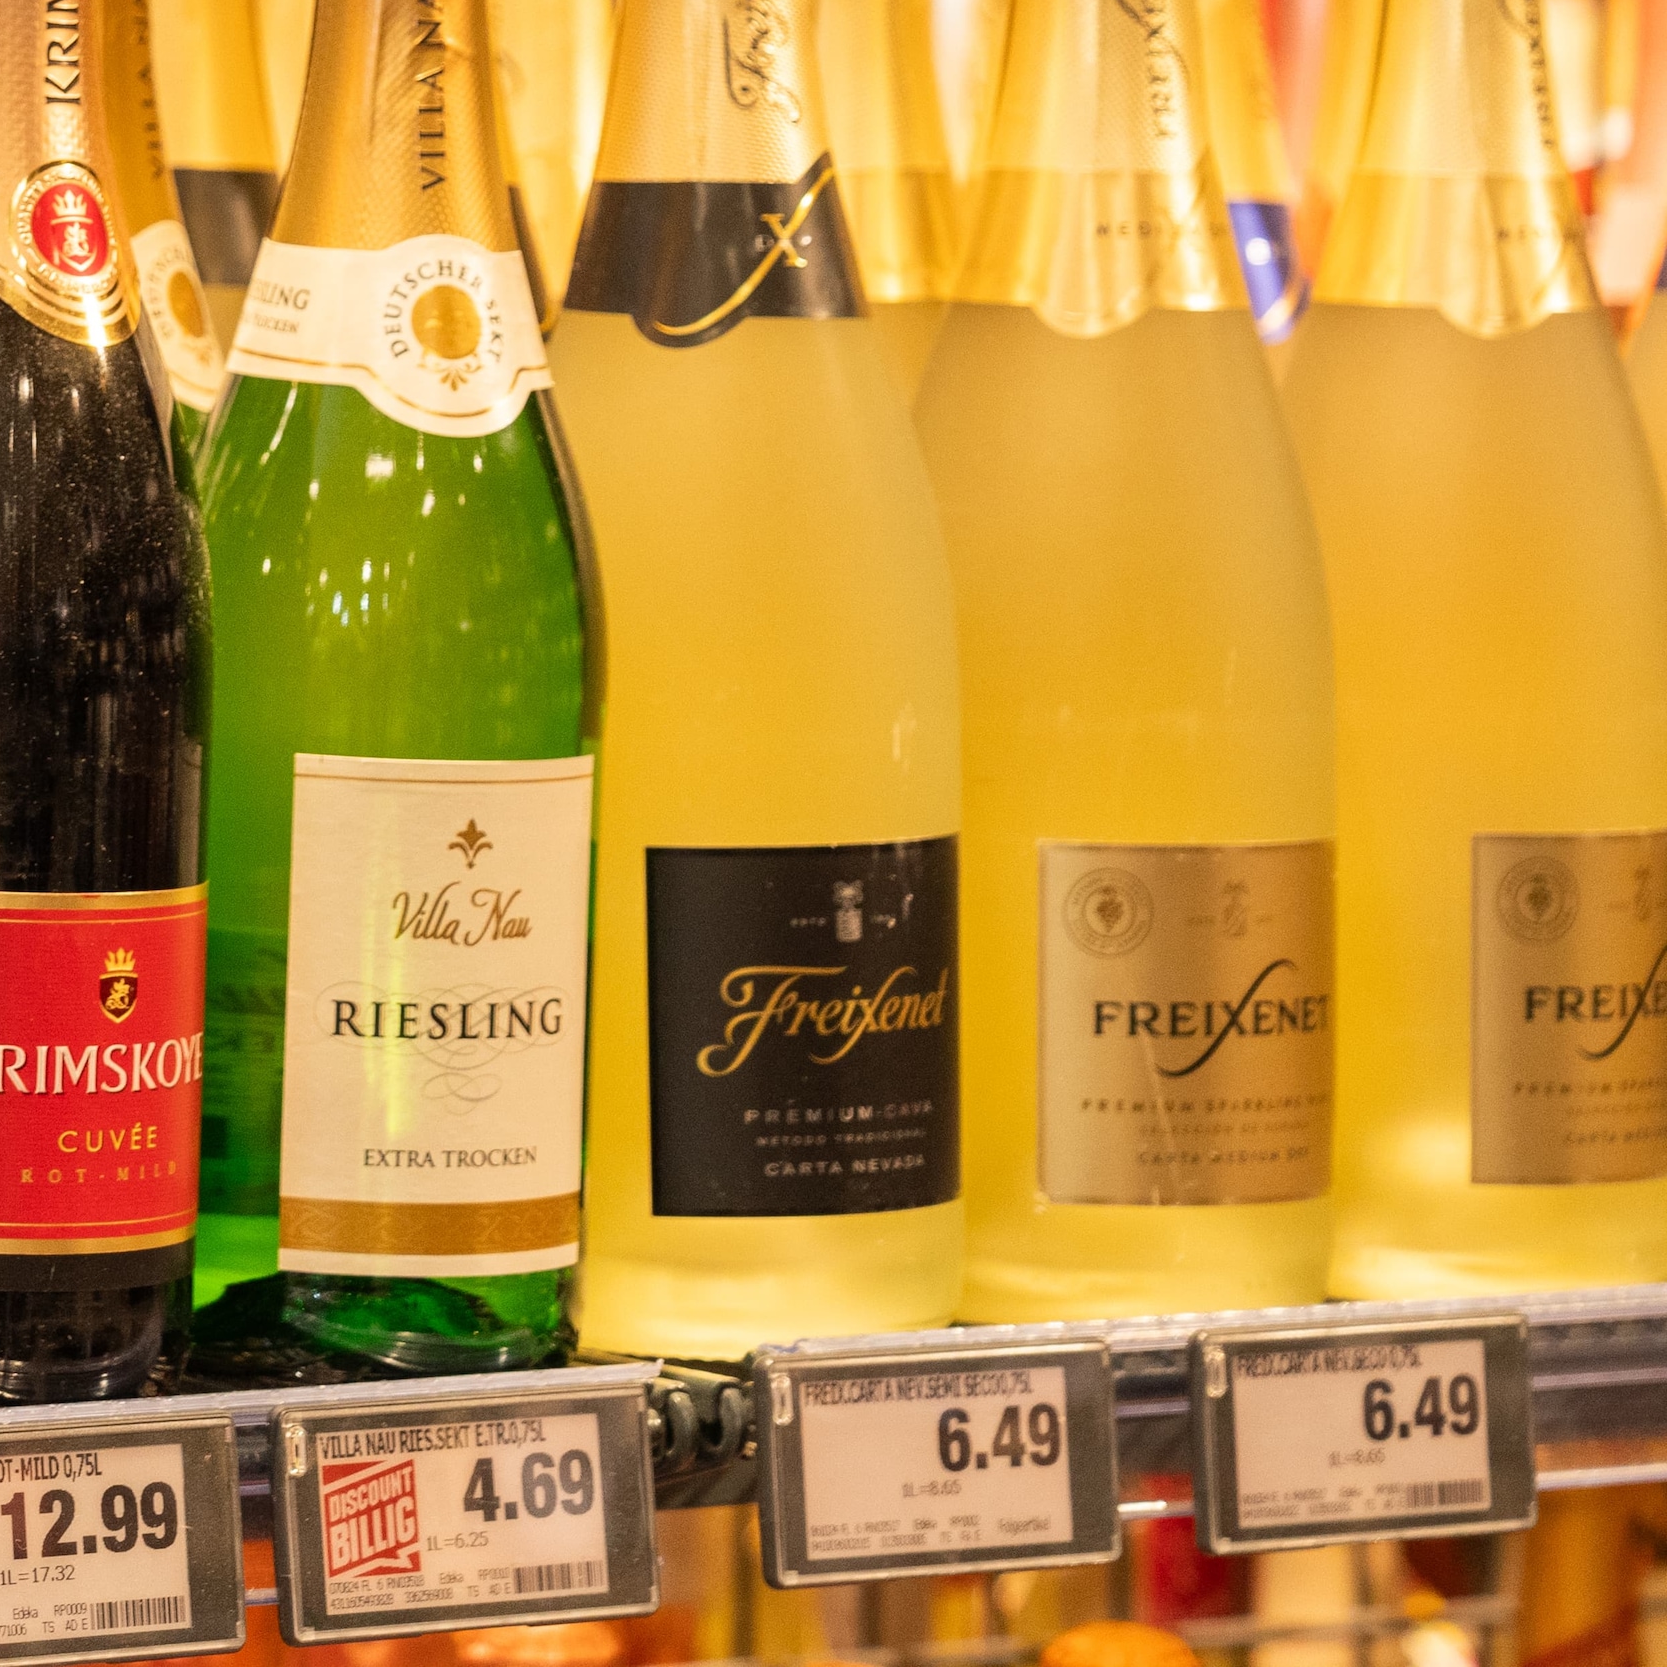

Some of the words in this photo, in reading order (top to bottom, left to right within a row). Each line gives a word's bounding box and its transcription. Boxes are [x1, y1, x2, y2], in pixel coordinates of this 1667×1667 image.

[416, 65, 446, 192] VILLA
[382, 259, 485, 360] DEUTSCHER
[483, 297, 507, 364] SEKT
[392, 881, 462, 946] Villa
[463, 888, 533, 947] Nau
[331, 997, 563, 1040] RIESLING
[695, 965, 949, 1078] Freixenet
[57, 1121, 158, 1154] CUVÉE
[363, 1147, 436, 1169] EXTRA
[441, 1145, 538, 1169] TROCKEN
[764, 1159, 843, 1177] CARTA
[851, 1153, 926, 1175] NEVADA
[1363, 1374, 1480, 1441] 6.49
[320, 1433, 363, 1460] VILLA
[366, 1429, 398, 1457] NAU
[937, 1401, 1061, 1473] 6.49
[62, 1452, 102, 1481] 0,75L
[329, 1466, 413, 1523] DISCOUNT
[463, 1448, 595, 1522] 4.69
[0, 1480, 179, 1561] 12.99
[329, 1495, 416, 1571] BILLIG
[0, 1564, 77, 1587] 1L=17.32
[12, 1607, 38, 1620] Edeka
[42, 1621, 55, 1634] TS
